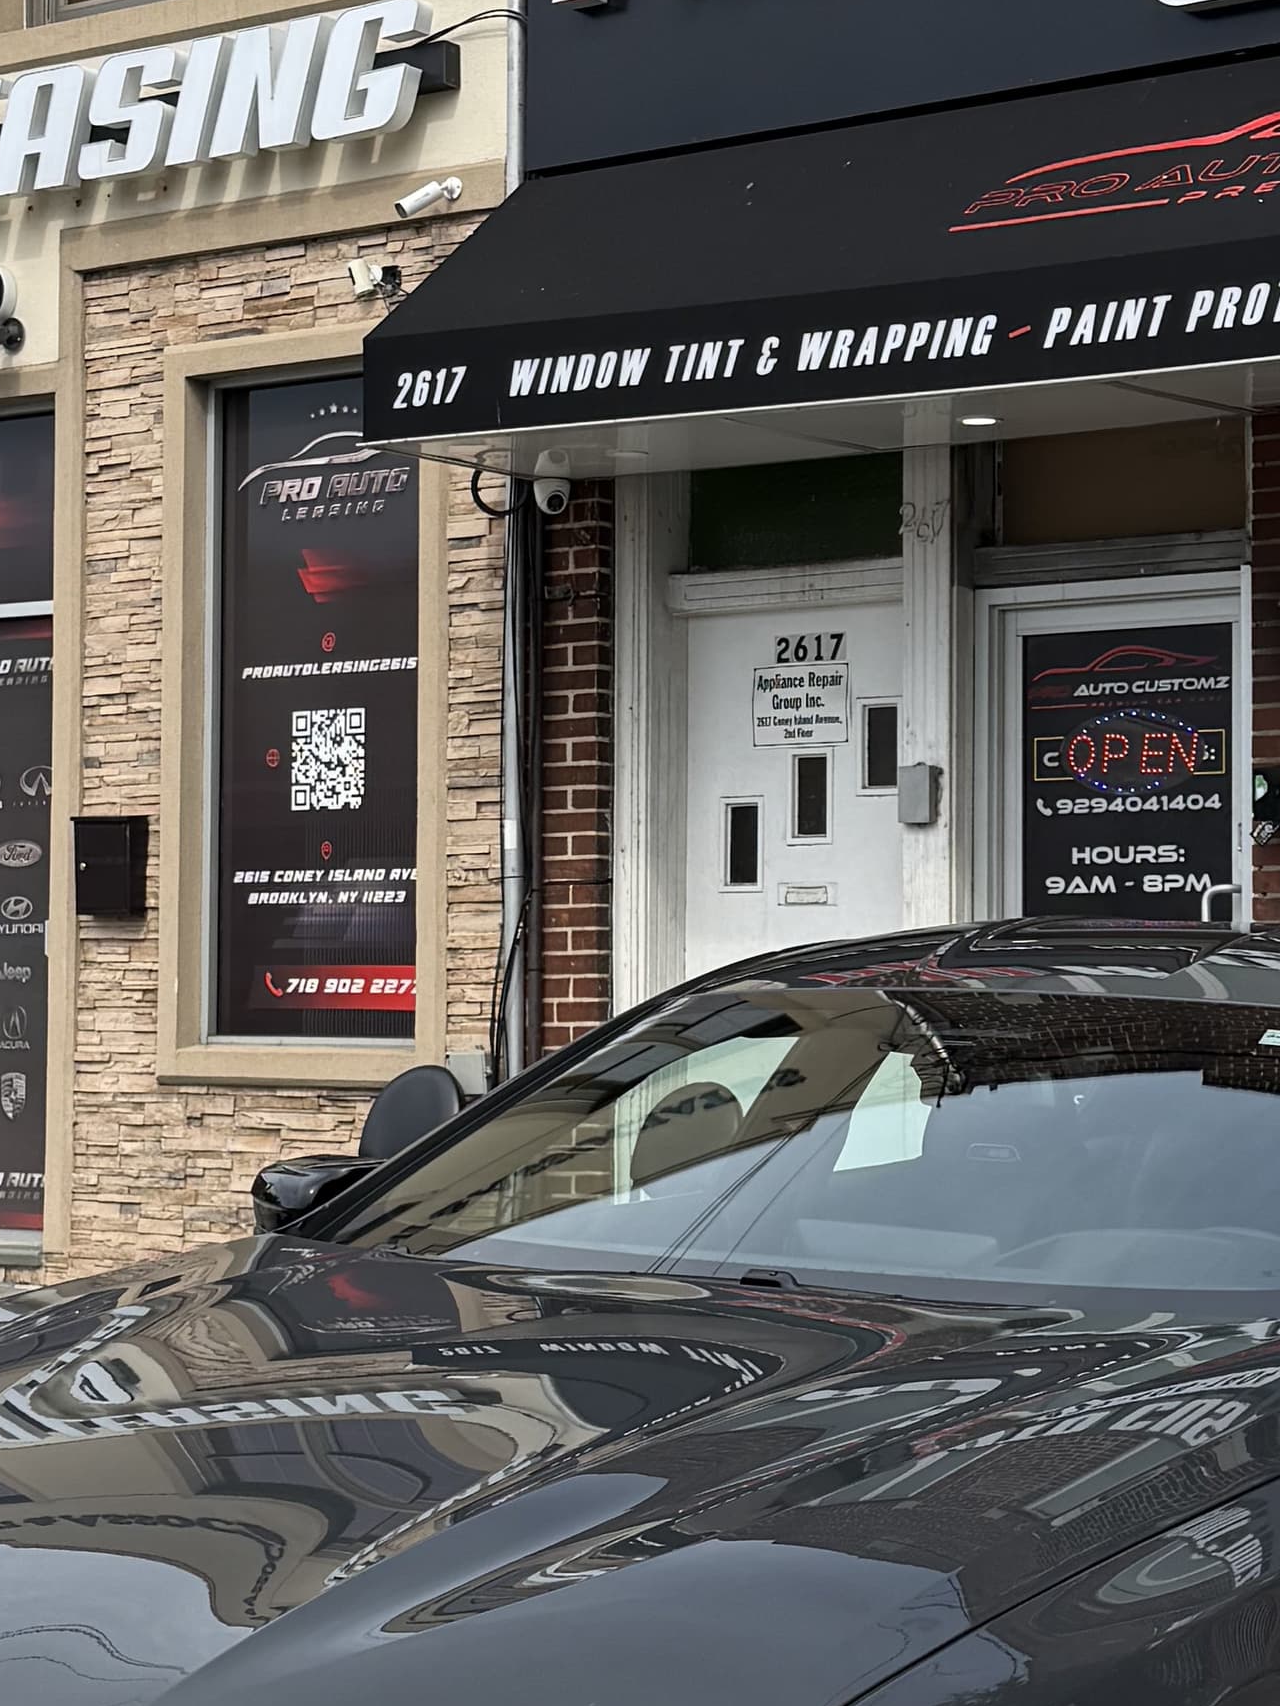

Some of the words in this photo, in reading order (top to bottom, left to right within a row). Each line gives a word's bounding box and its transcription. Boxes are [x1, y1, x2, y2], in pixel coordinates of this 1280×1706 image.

[964, 173, 1131, 215] PRO
[392, 365, 467, 409] 2617
[508, 347, 651, 398] WINDOW
[664, 337, 741, 384] TINT
[756, 336, 779, 376] &
[796, 313, 999, 372] WRAPPING
[1043, 293, 1174, 350] PAINT
[259, 476, 323, 505] PRO
[326, 467, 410, 498] AUTO
[281, 499, 386, 522] LEASING
[776, 633, 844, 663] 2617
[241, 656, 419, 679] PROAUTOLEASING2615
[808, 670, 844, 689] Repair
[1073, 682, 1129, 697] AUTO
[1131, 676, 1231, 694] CUSTOMZ
[772, 694, 802, 711] Group
[806, 693, 825, 708] Inc.
[784, 728, 796, 739] 2nd
[1067, 732, 1199, 774] OPEN
[1056, 793, 1222, 815] 9294041404
[2, 844, 32, 861] Ford
[1071, 844, 1186, 866] HOURS:
[233, 870, 272, 883] 2615
[273, 869, 324, 883] CONEY
[327, 868, 385, 881] ISLAND
[1045, 874, 1117, 895] 9AM
[1142, 873, 1212, 893] 8PM
[338, 891, 359, 903] NY
[362, 890, 406, 903] 11223
[286, 978, 320, 993] 718
[324, 978, 365, 993] 902
